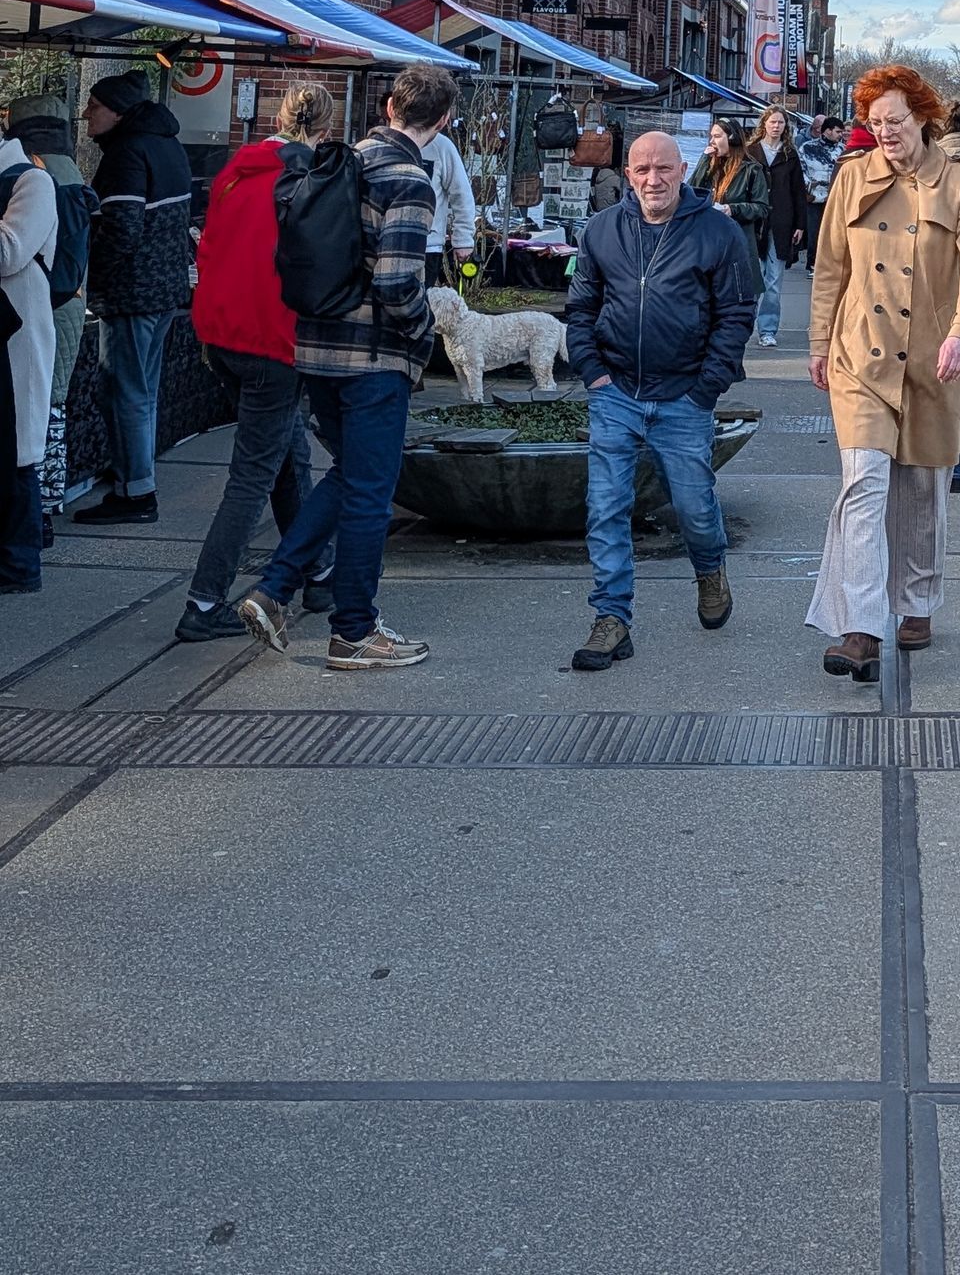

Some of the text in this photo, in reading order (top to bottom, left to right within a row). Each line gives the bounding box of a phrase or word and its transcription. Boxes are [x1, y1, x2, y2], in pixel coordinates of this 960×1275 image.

[789, 5, 798, 88] AMSTERDAM IN
[796, 5, 805, 43] MOTION
